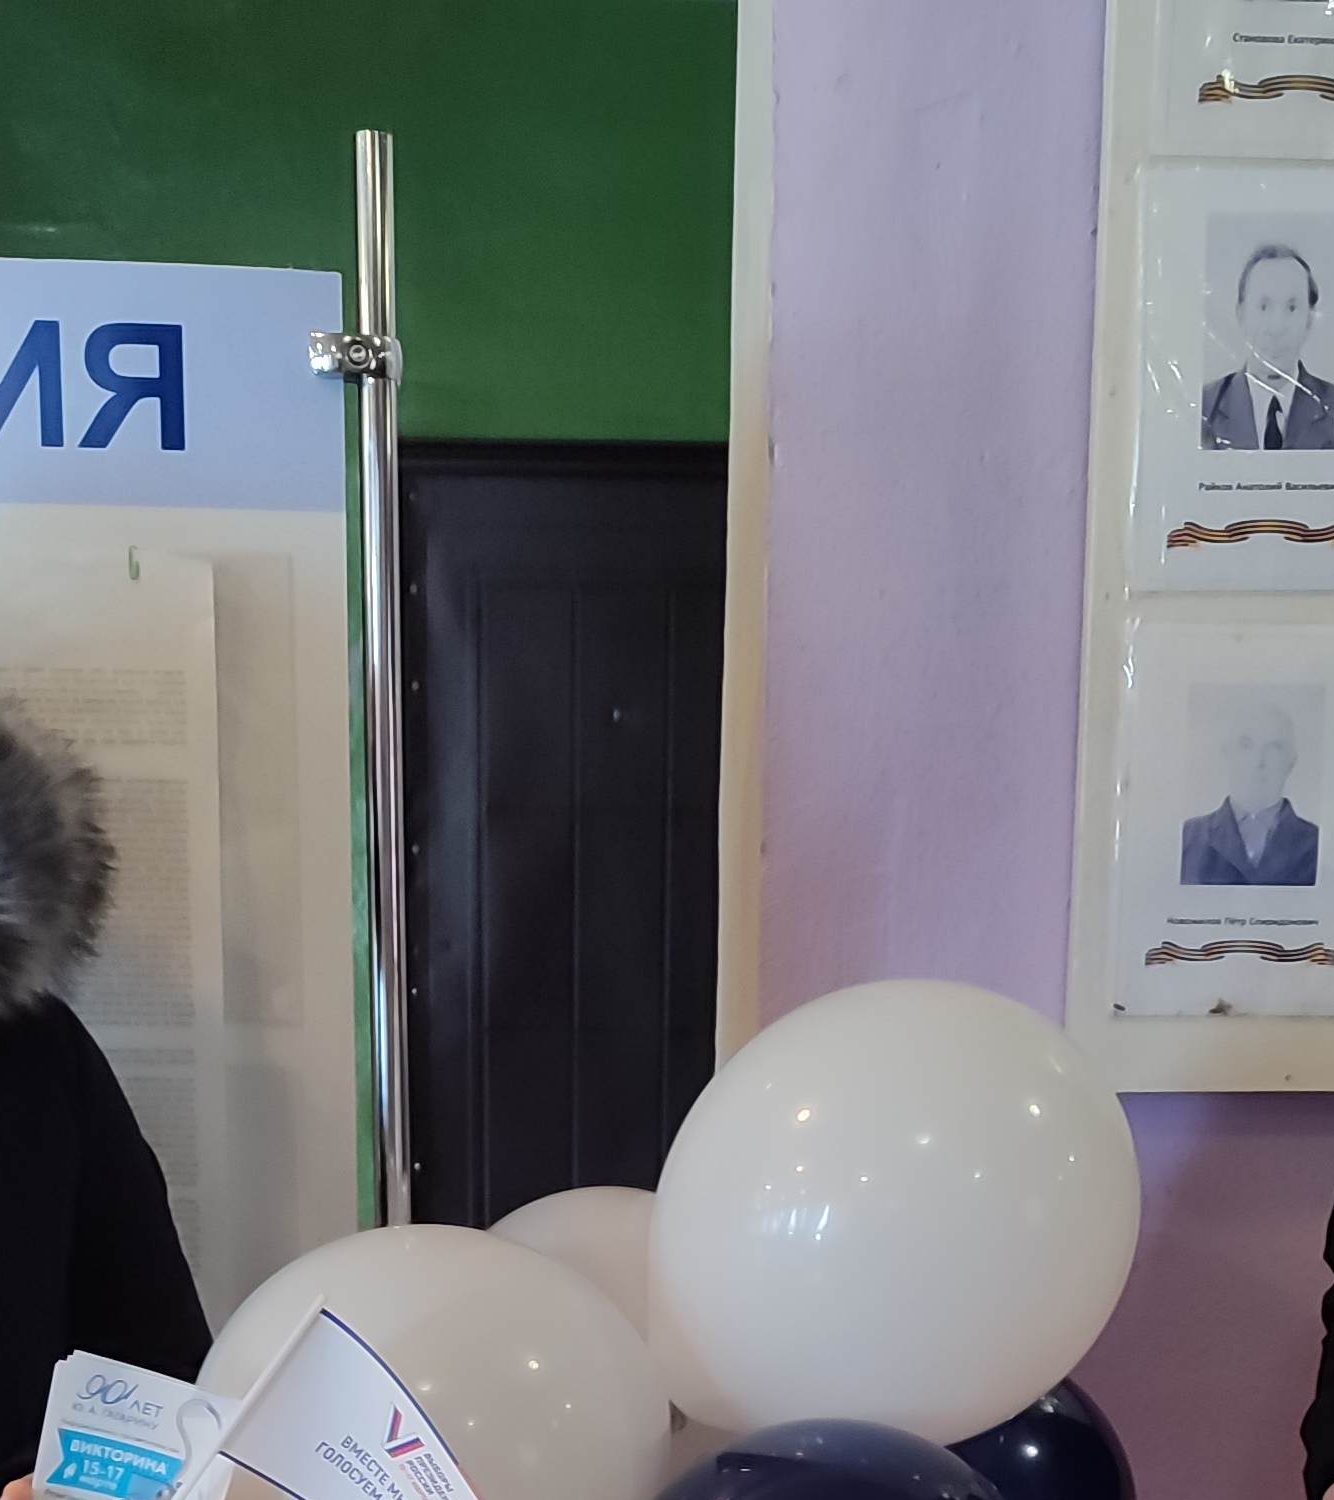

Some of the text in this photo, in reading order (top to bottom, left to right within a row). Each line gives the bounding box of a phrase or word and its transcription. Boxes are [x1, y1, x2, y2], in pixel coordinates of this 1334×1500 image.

[101, 1408, 160, 1430] ГАГАРИНУ
[128, 1400, 165, 1418] ЛЕТ
[69, 1438, 167, 1476] ВИКТОРИНА
[82, 1459, 125, 1480] 15-17
[340, 1435, 390, 1485] ВМЕСТЕ
[404, 1459, 435, 1496] РОССИИ
